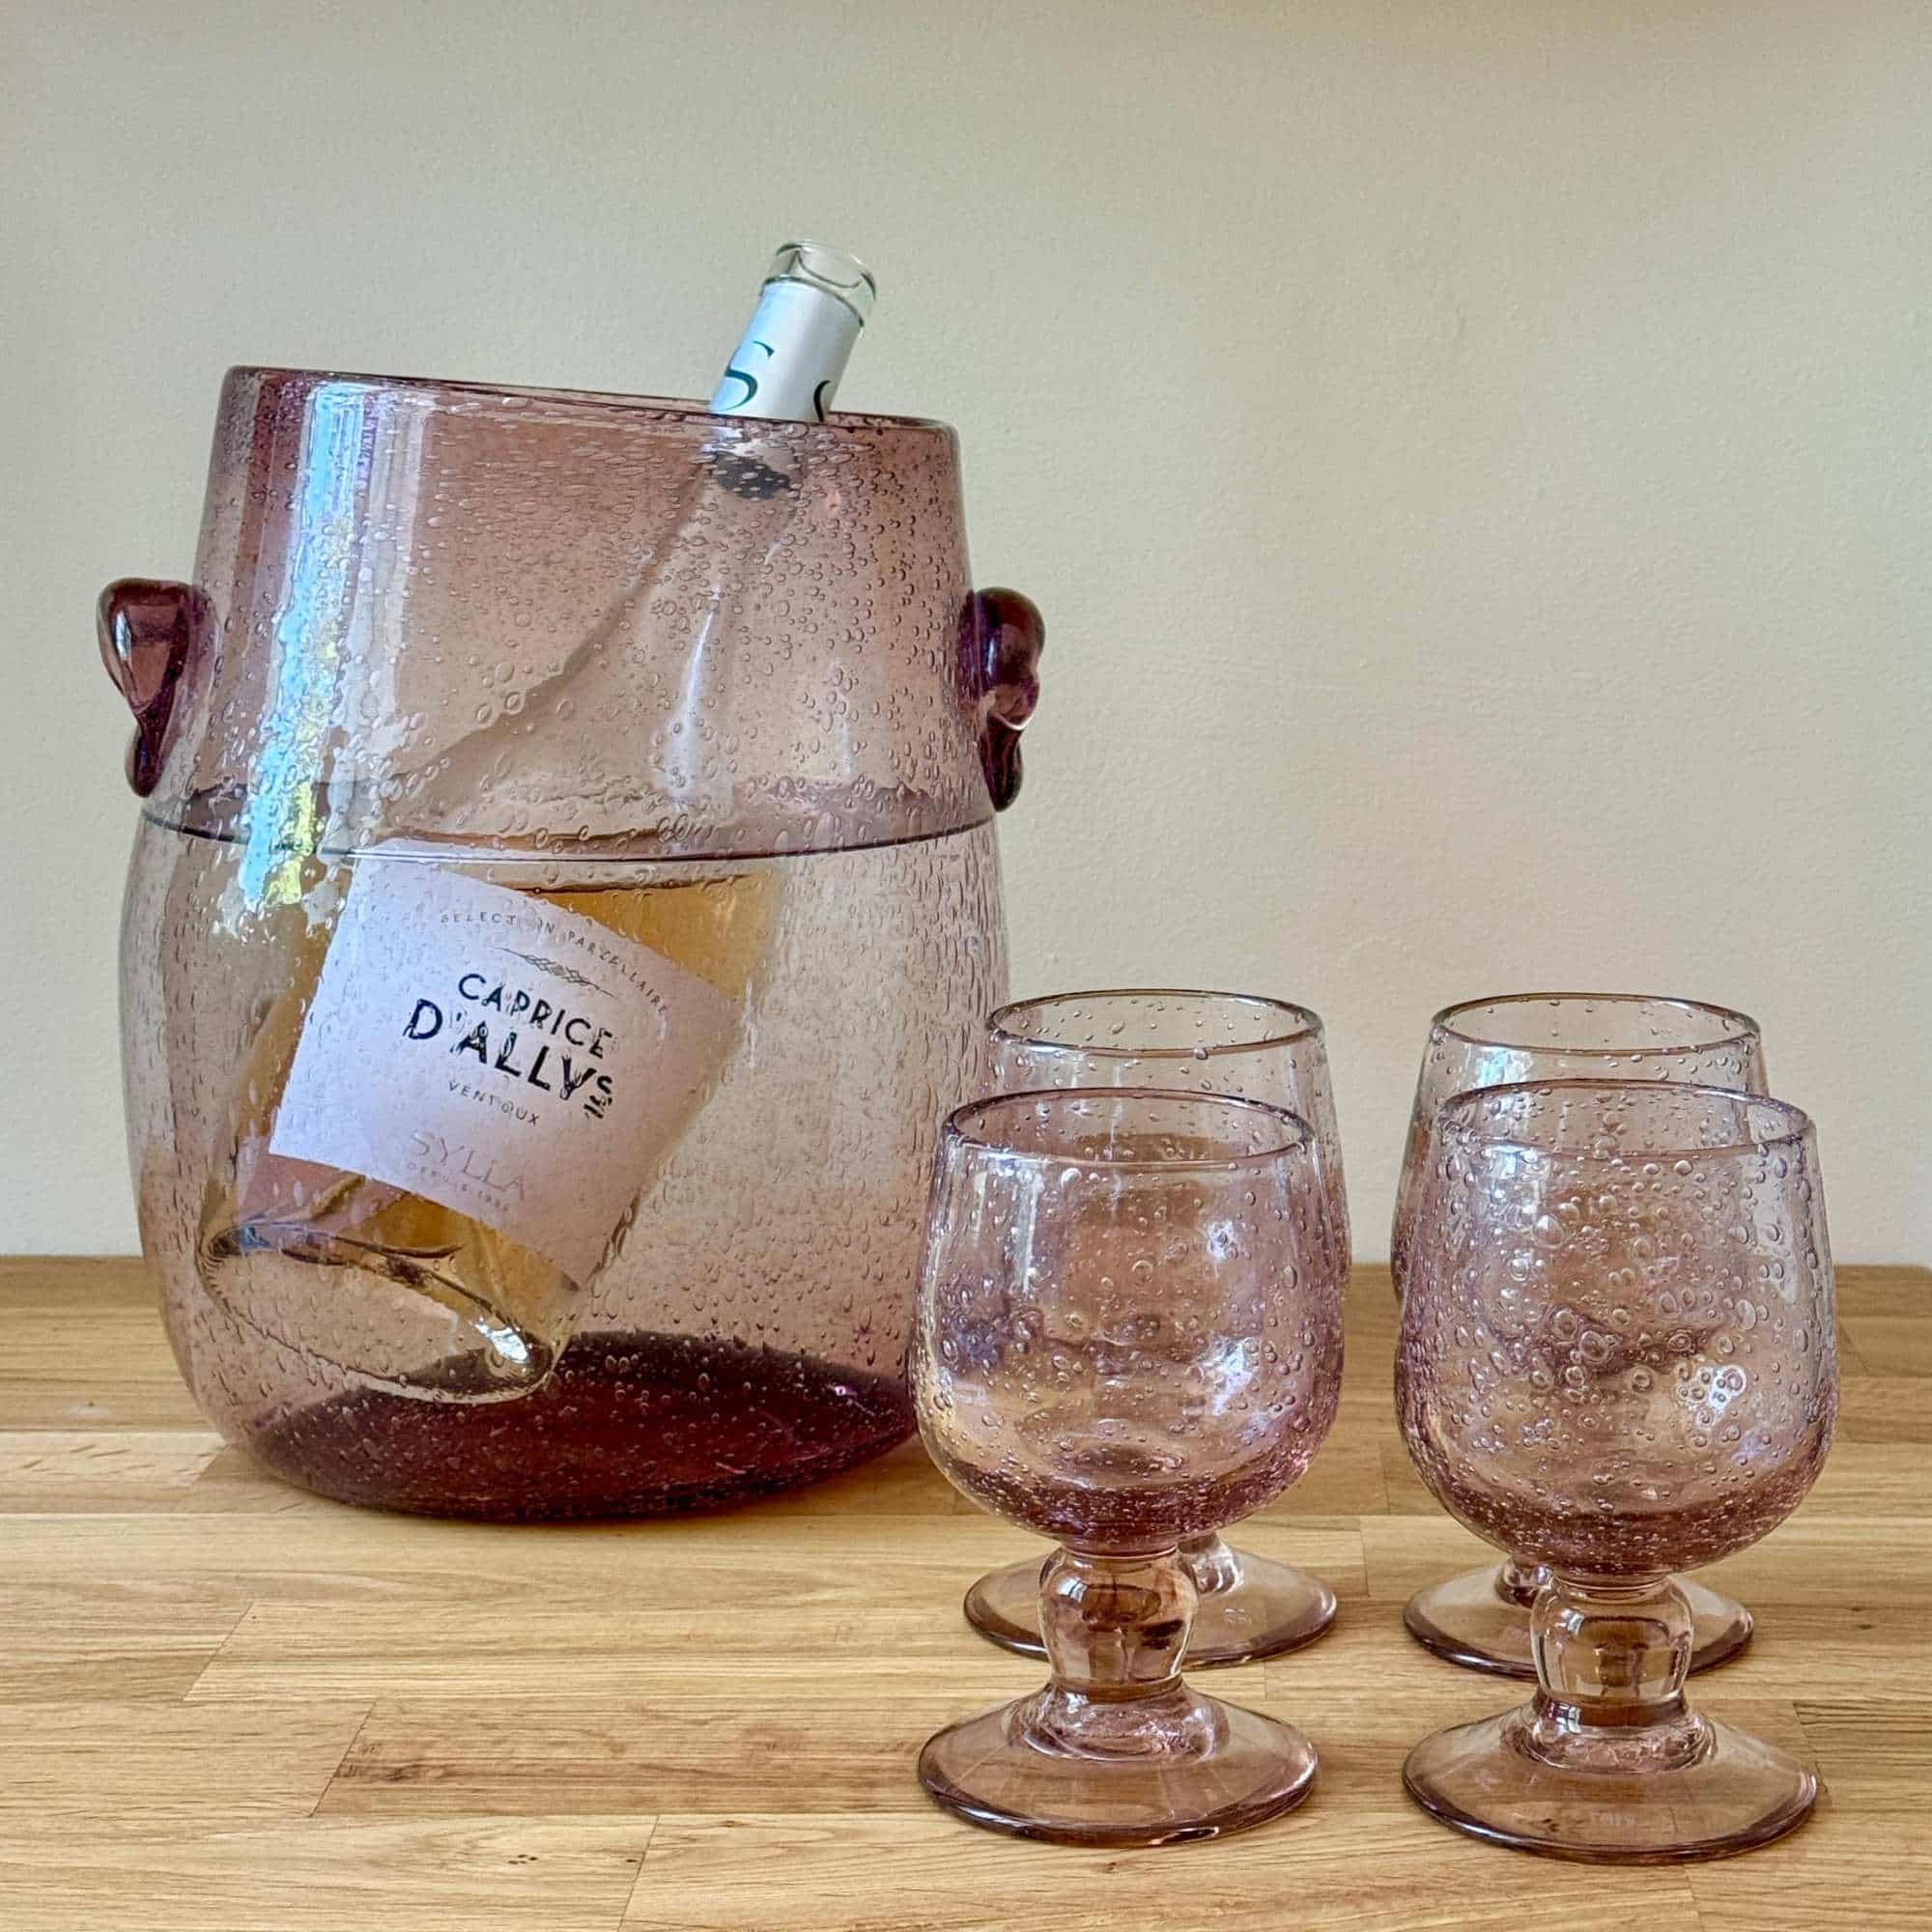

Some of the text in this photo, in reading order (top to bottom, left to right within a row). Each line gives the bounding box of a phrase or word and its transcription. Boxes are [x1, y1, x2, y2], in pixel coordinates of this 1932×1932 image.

[458, 974, 613, 1060] CAPRICE
[448, 1081, 540, 1125] VENTOUX
[411, 1130, 526, 1202] SYLLA
